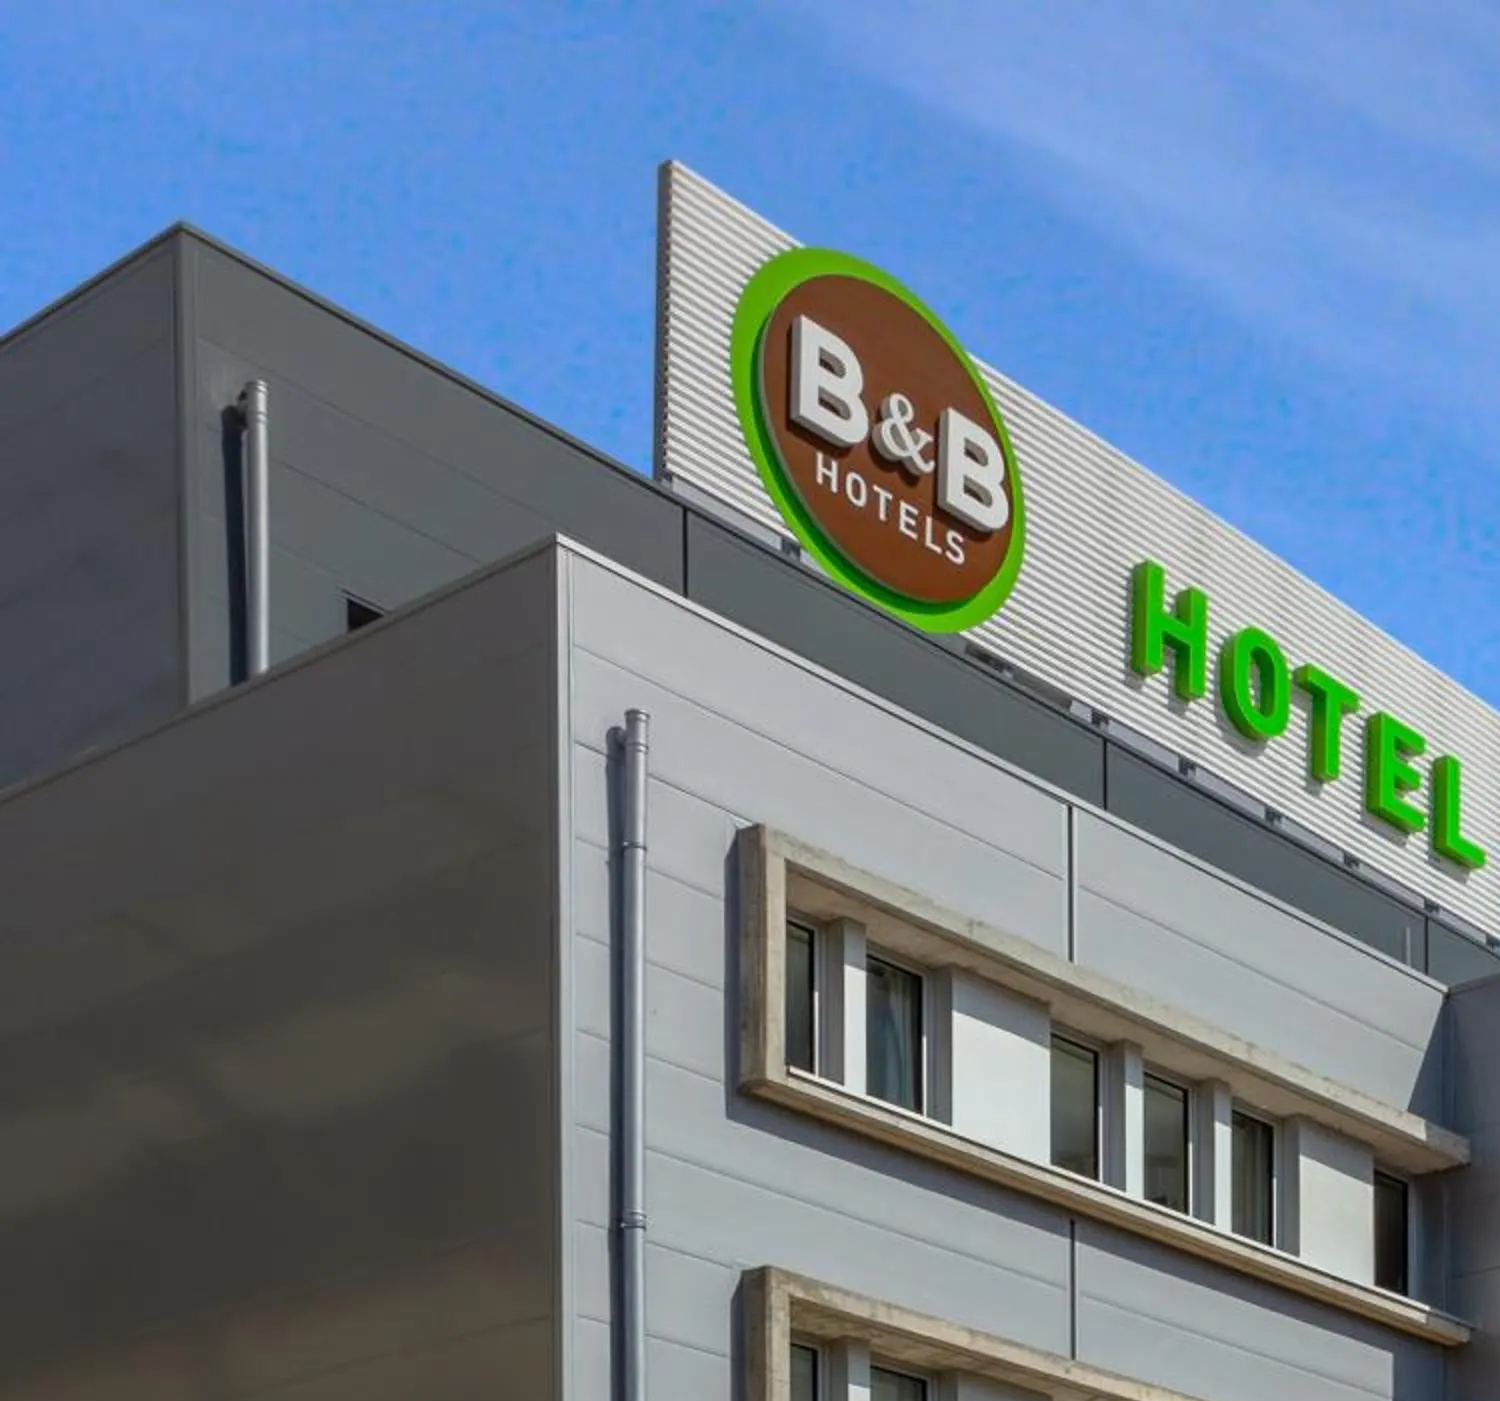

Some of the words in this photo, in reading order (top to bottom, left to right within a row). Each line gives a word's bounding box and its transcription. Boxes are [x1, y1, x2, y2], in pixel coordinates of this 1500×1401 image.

[787, 314, 1009, 532] B&B
[815, 451, 966, 565] HOTELS
[1130, 559, 1487, 869] HOTEL
